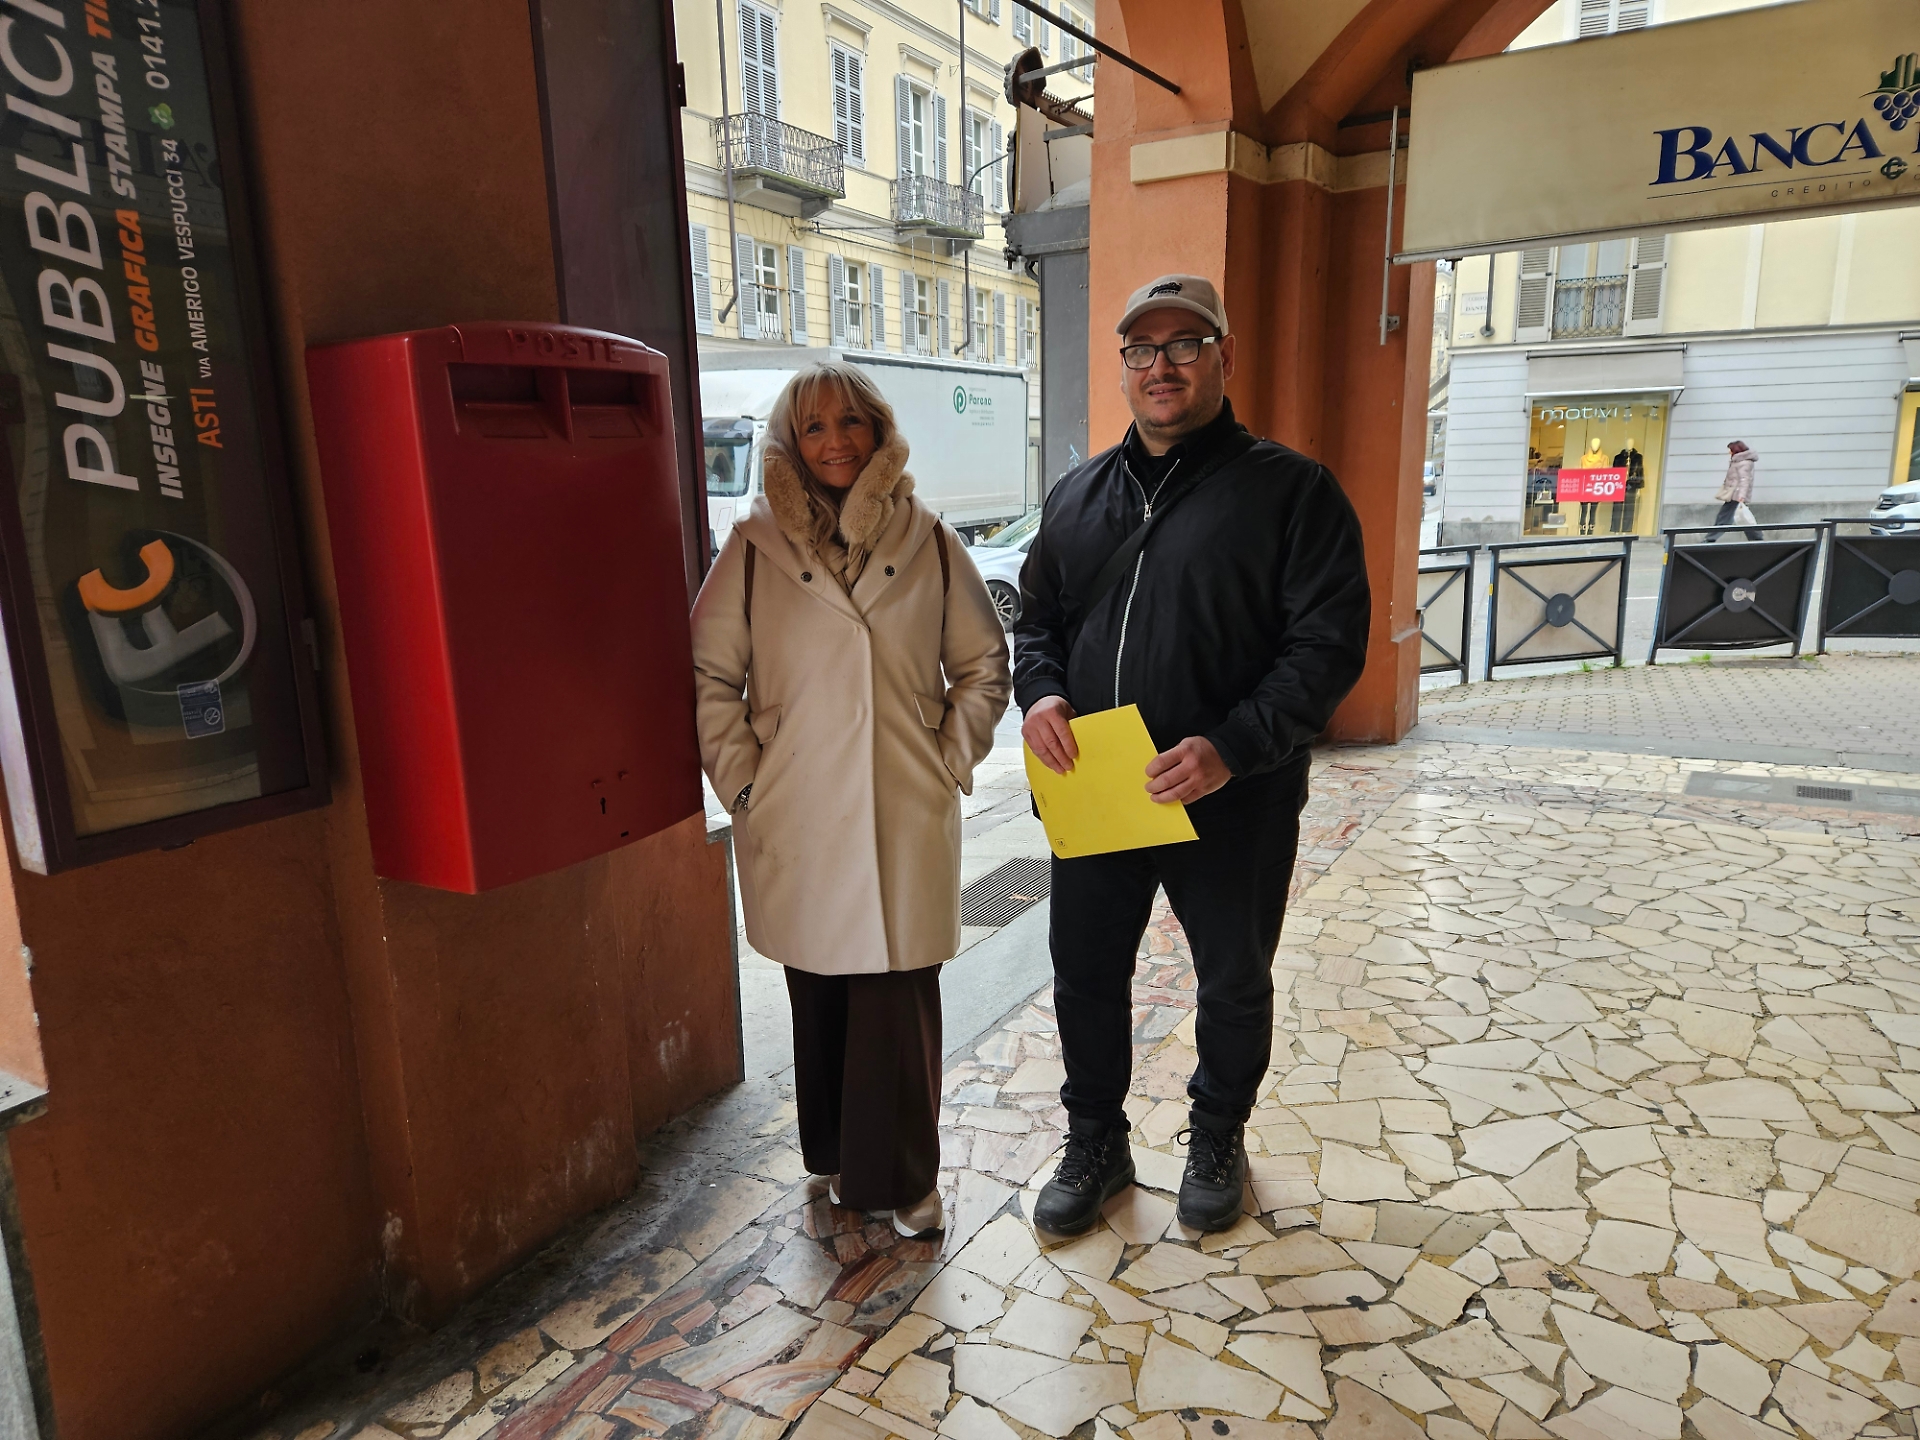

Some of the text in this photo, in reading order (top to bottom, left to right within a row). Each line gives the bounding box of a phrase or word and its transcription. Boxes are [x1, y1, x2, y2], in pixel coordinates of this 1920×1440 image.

[92, 52, 137, 199] STAMPA
[160, 138, 179, 163] 34
[1649, 118, 1885, 186] BANCA
[166, 168, 195, 260] VESPUCCI
[1771, 178, 1871, 198] CREDITO
[115, 209, 159, 351] GRAFICA
[181, 266, 209, 351] AMERIGO
[200, 357, 212, 378] VIA
[506, 328, 623, 364] POSTE
[140, 360, 183, 498] INSEGNE
[190, 388, 223, 448] ASTI
[1541, 406, 1618, 421] motivi
